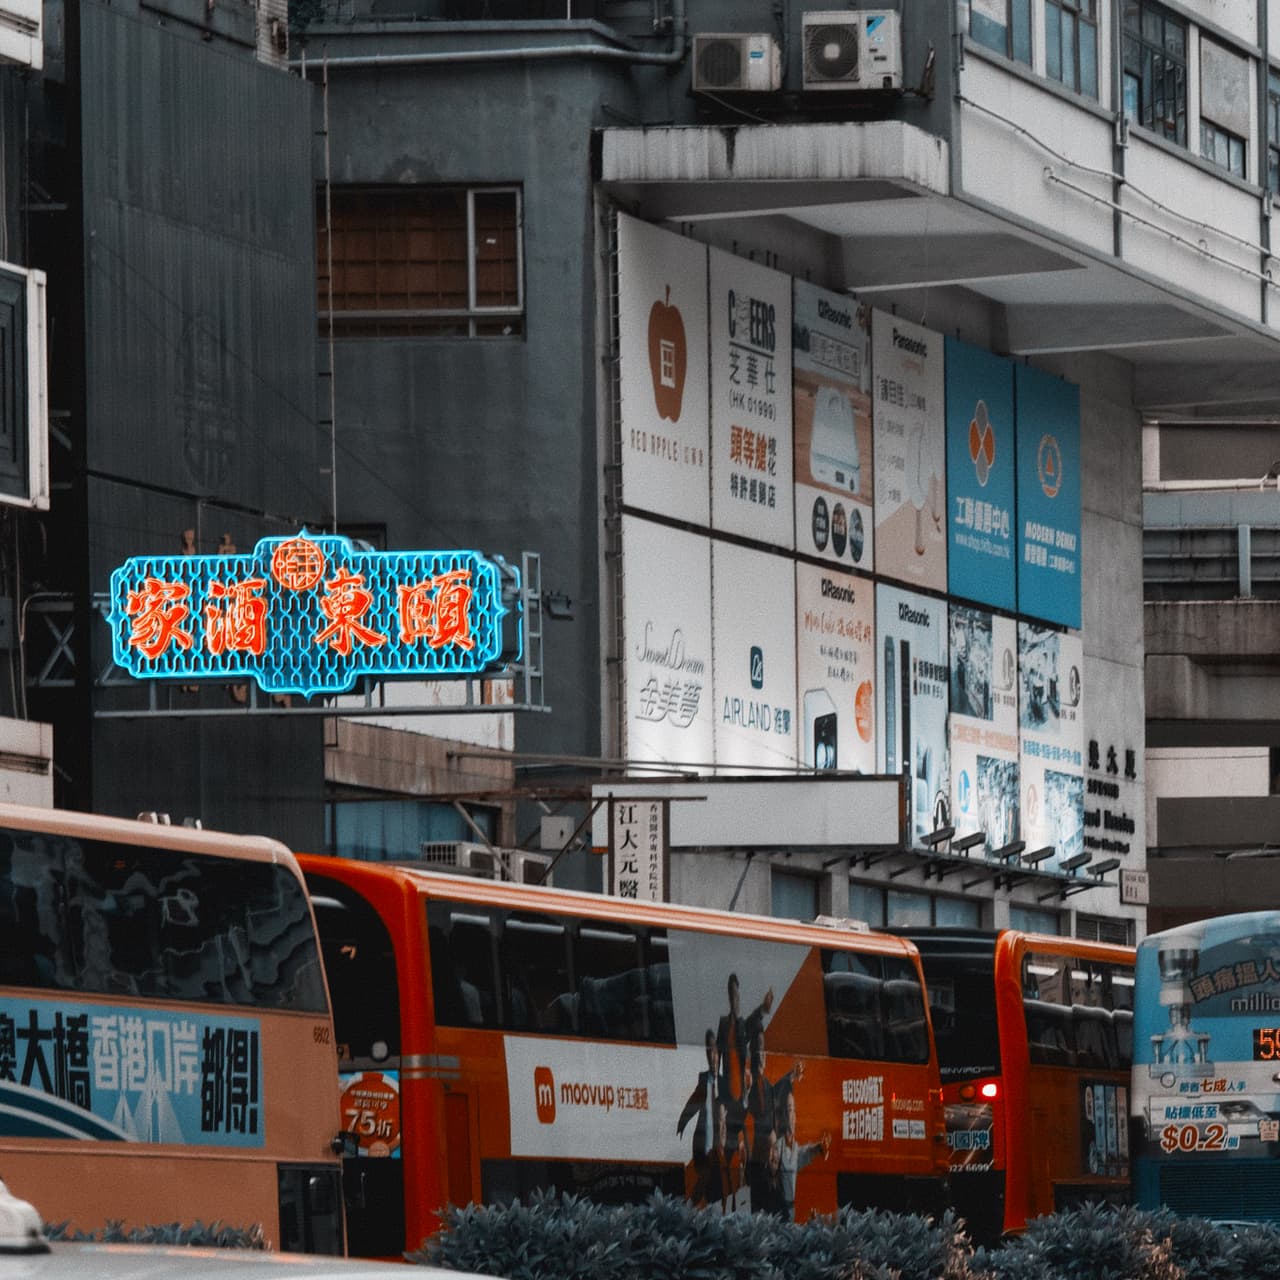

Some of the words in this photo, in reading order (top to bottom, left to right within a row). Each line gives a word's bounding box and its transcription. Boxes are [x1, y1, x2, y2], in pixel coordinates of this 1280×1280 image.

[631, 429, 648, 454] RED
[650, 433, 678, 462] APPLE
[730, 425, 767, 473] 頭等艙
[827, 580, 855, 604] Rasonic
[904, 604, 930, 627] Rasonic
[723, 696, 771, 732] AIRLAND
[560, 1082, 614, 1113] moovup
[1164, 1104, 1219, 1120] 貼標低至
